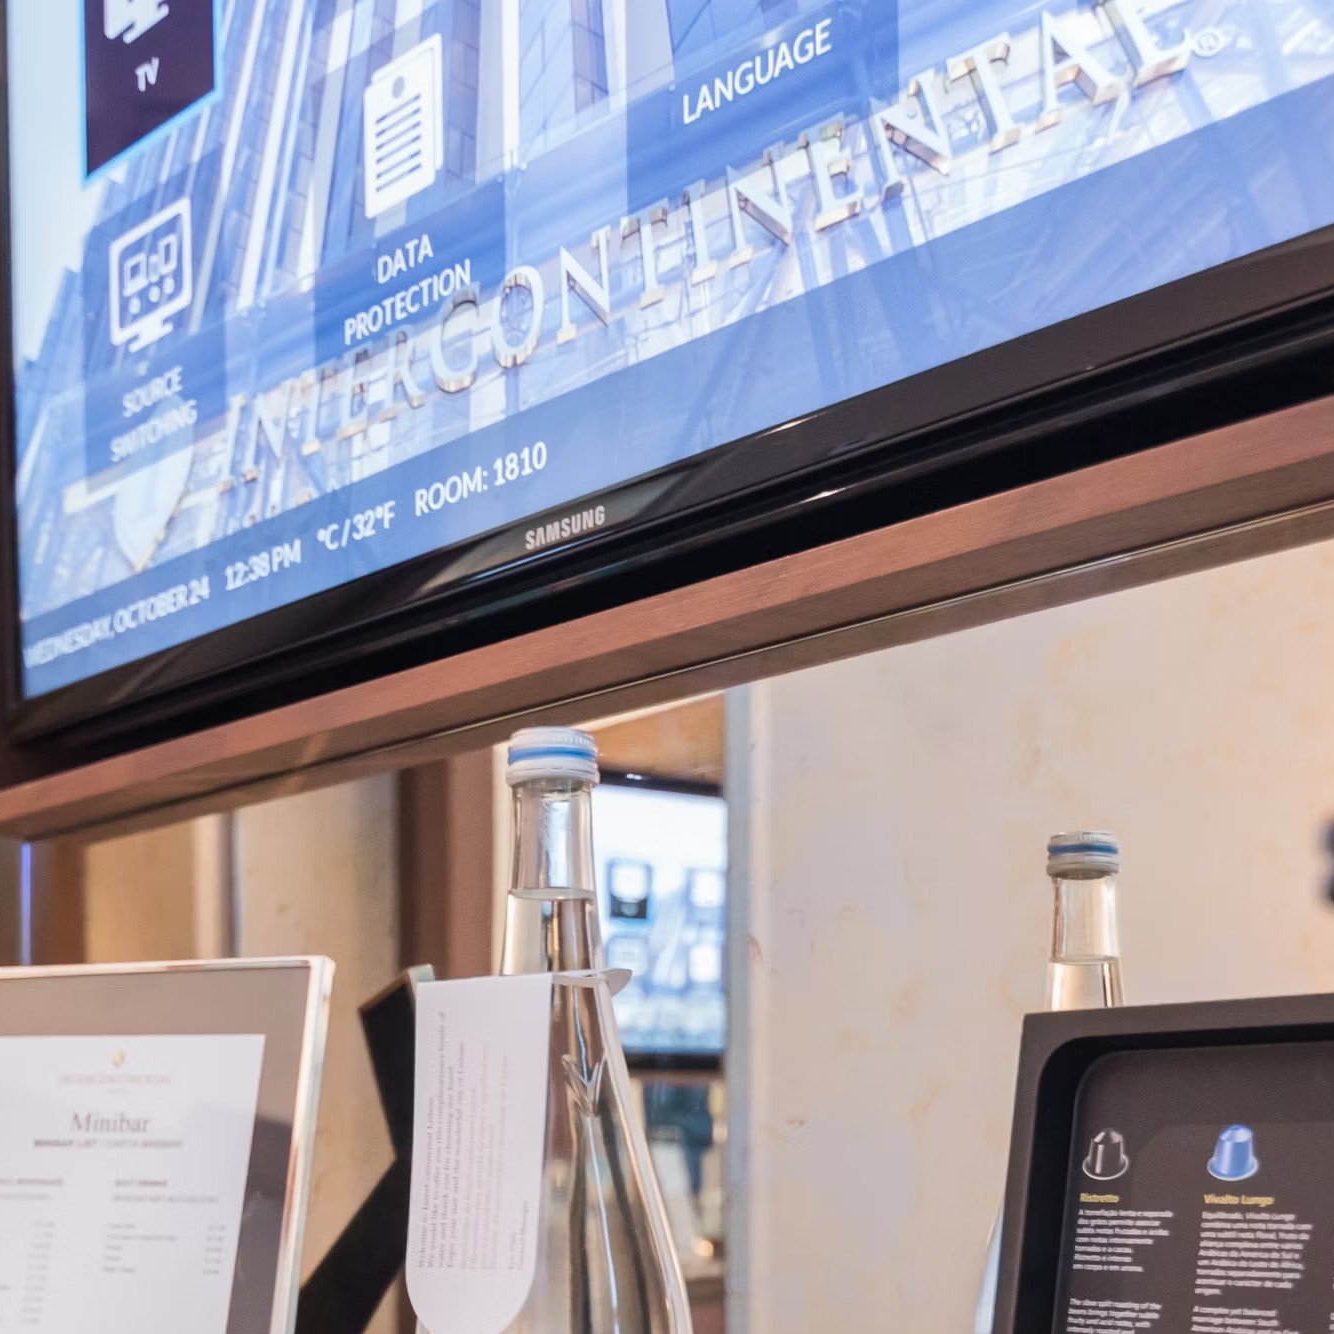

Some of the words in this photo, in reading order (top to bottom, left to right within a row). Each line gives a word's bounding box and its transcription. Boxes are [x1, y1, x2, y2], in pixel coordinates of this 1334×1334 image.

[135, 56, 160, 92] TV
[682, 18, 833, 125] LANGUAGE
[219, 0, 1195, 495] INTERCONTINENTAL
[377, 234, 434, 285] DATA
[344, 258, 471, 345] PROTECTION
[123, 366, 183, 418] SOURCE
[110, 399, 198, 462] SWITCHING
[113, 585, 188, 633] OCTOBER
[187, 576, 210, 605] 24
[224, 553, 271, 591] 12:38
[270, 538, 302, 573] PM
[415, 464, 488, 516] ROOM:
[493, 441, 547, 487] 1810
[525, 505, 605, 550] SAMSUNG
[71, 1112, 151, 1133] Minibar
[1080, 1193, 1119, 1202] Ristretto
[1204, 1194, 1240, 1204] Vivalto
[1241, 1195, 1275, 1207] Lungo
